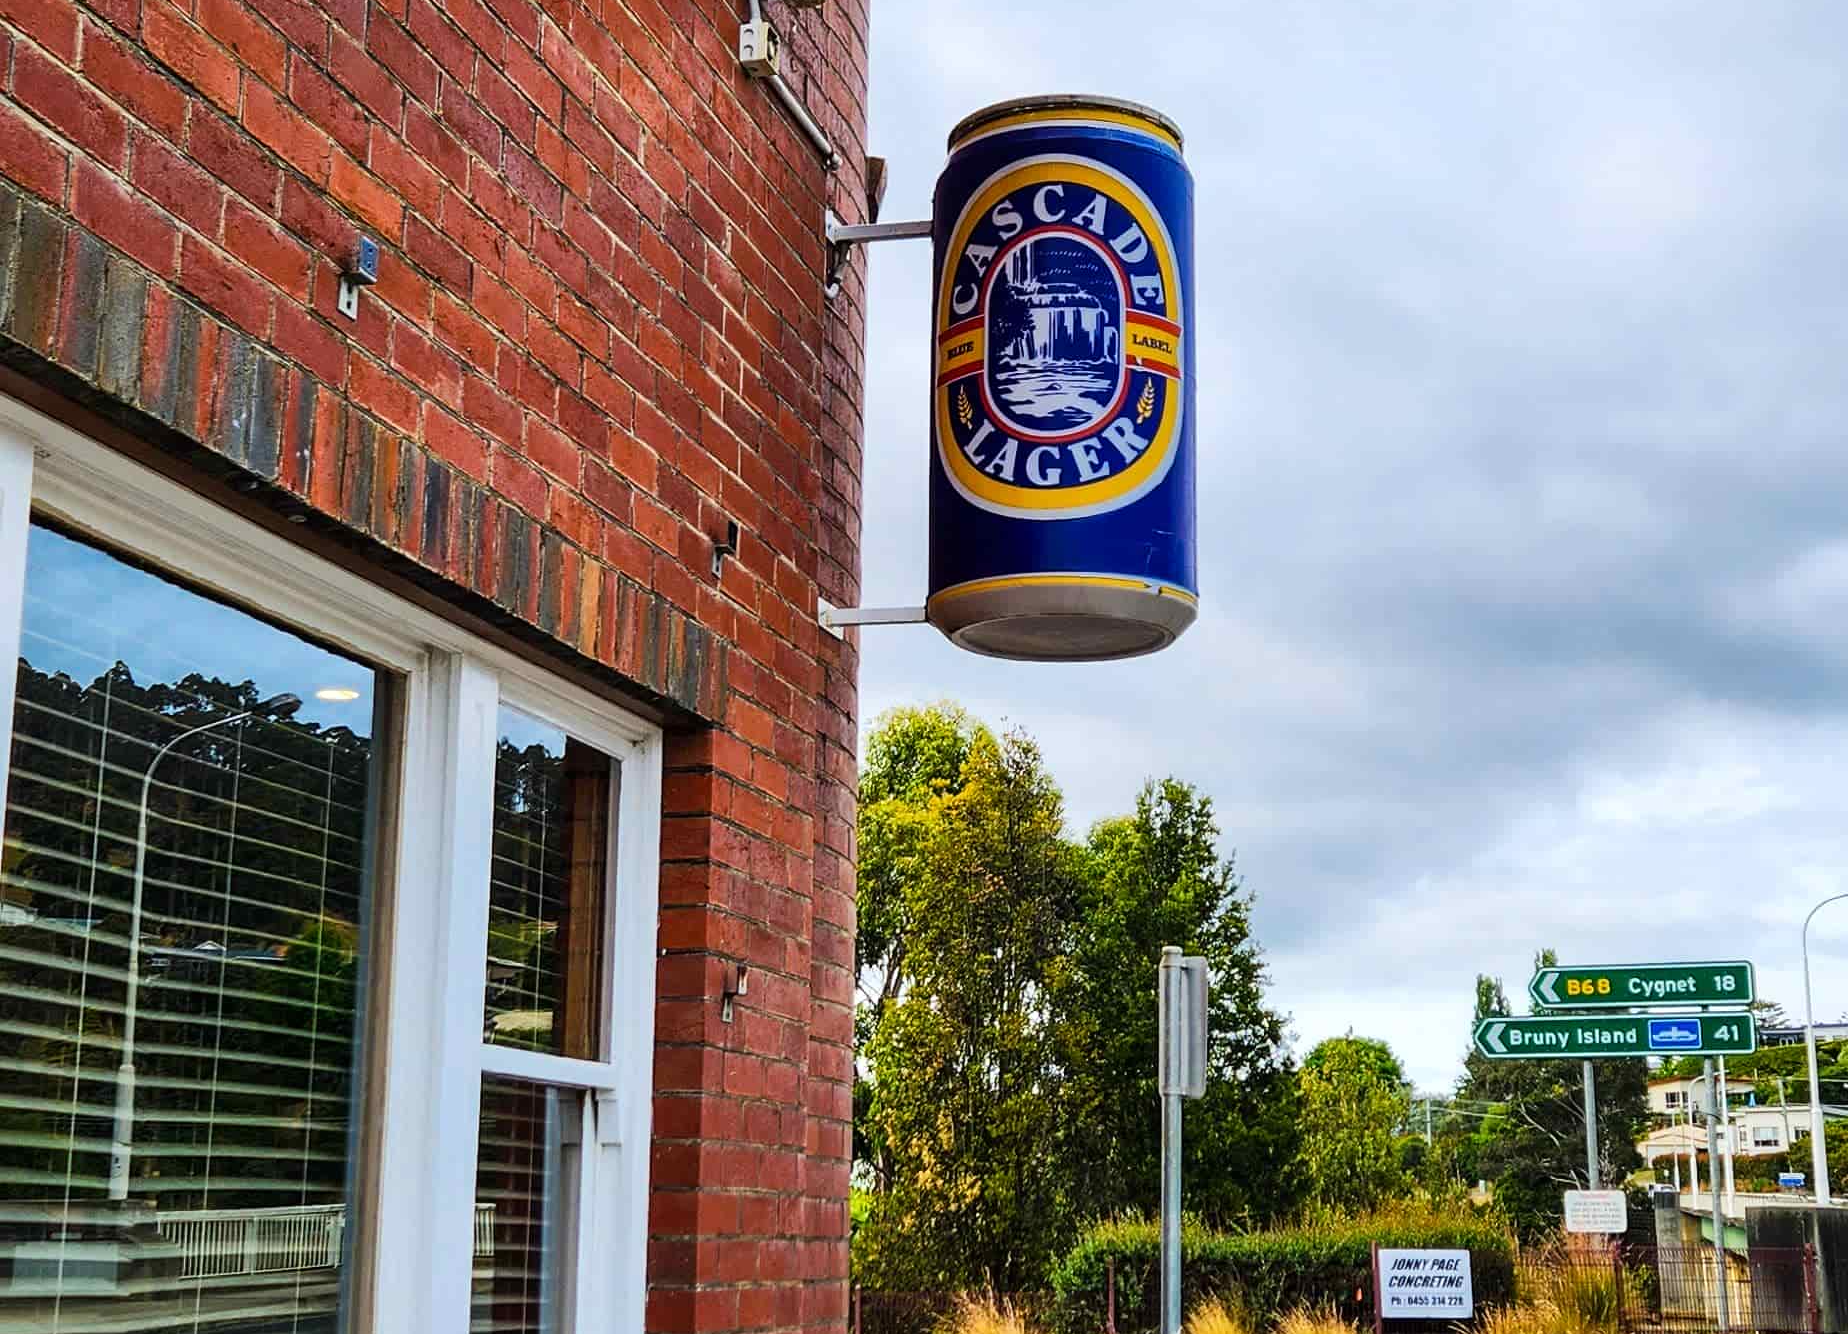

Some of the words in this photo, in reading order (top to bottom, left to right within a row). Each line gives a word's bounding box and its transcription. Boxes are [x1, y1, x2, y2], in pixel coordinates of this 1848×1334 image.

[953, 184, 1163, 314] CASCADE
[947, 340, 975, 360] BLUE
[1132, 333, 1173, 354] LABEL
[964, 418, 1150, 485] LAGER
[1567, 978, 1611, 995] B68
[1628, 976, 1697, 998] Cygnet
[1713, 975, 1736, 992] 18
[1509, 1028, 1569, 1050] Bruny
[1577, 1027, 1637, 1045] Island
[1713, 1024, 1739, 1042] 41
[1391, 1258, 1429, 1271] JONNY
[1431, 1258, 1461, 1271] PAGE
[1389, 1275, 1464, 1288] CONCRETING
